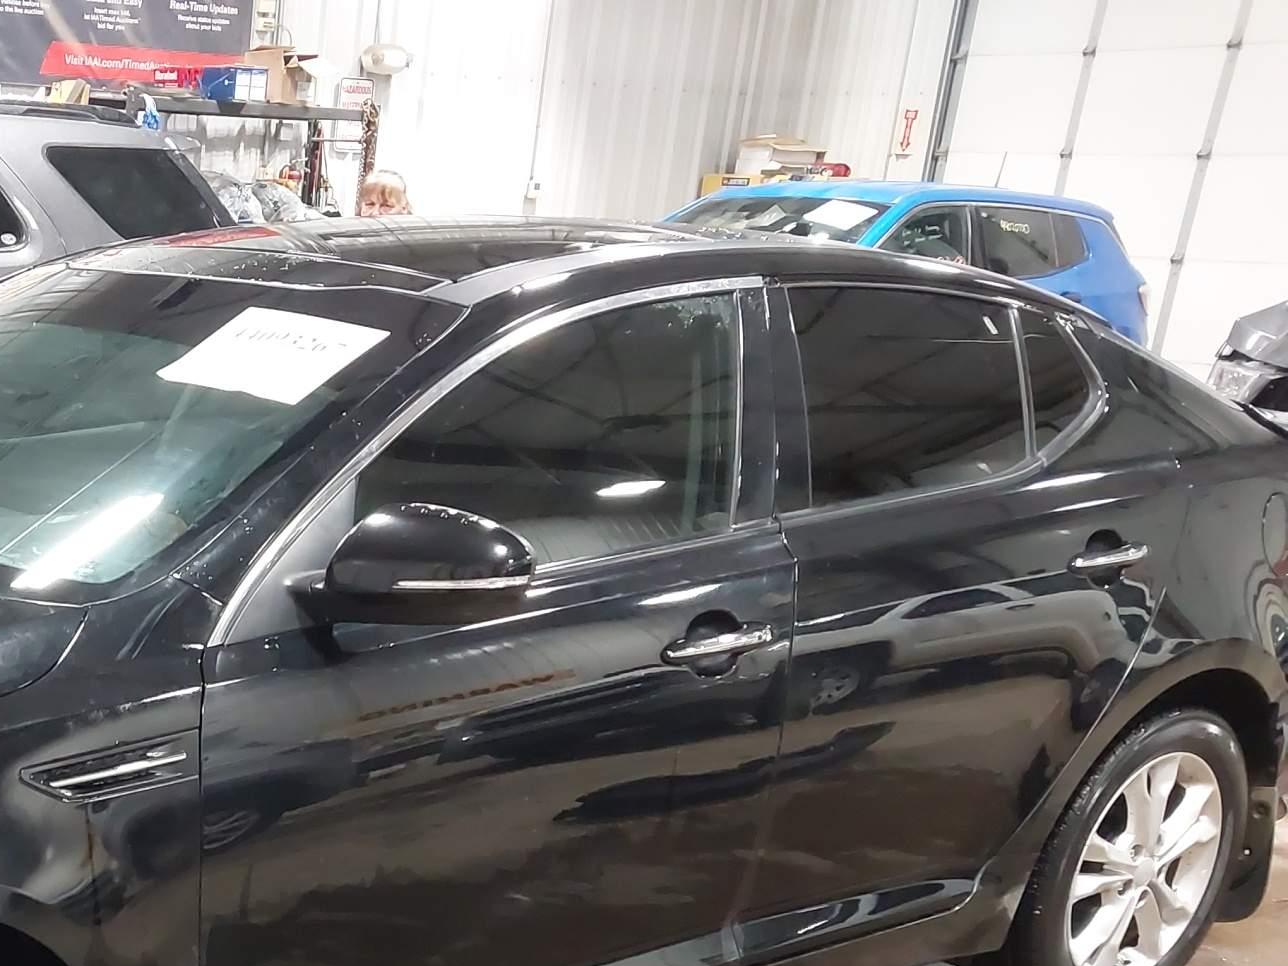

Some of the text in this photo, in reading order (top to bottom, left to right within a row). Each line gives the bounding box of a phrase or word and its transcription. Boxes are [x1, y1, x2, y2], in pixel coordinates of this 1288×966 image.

[170, 0, 239, 15] Real-Time Updates
[65, 54, 84, 65] Visit
